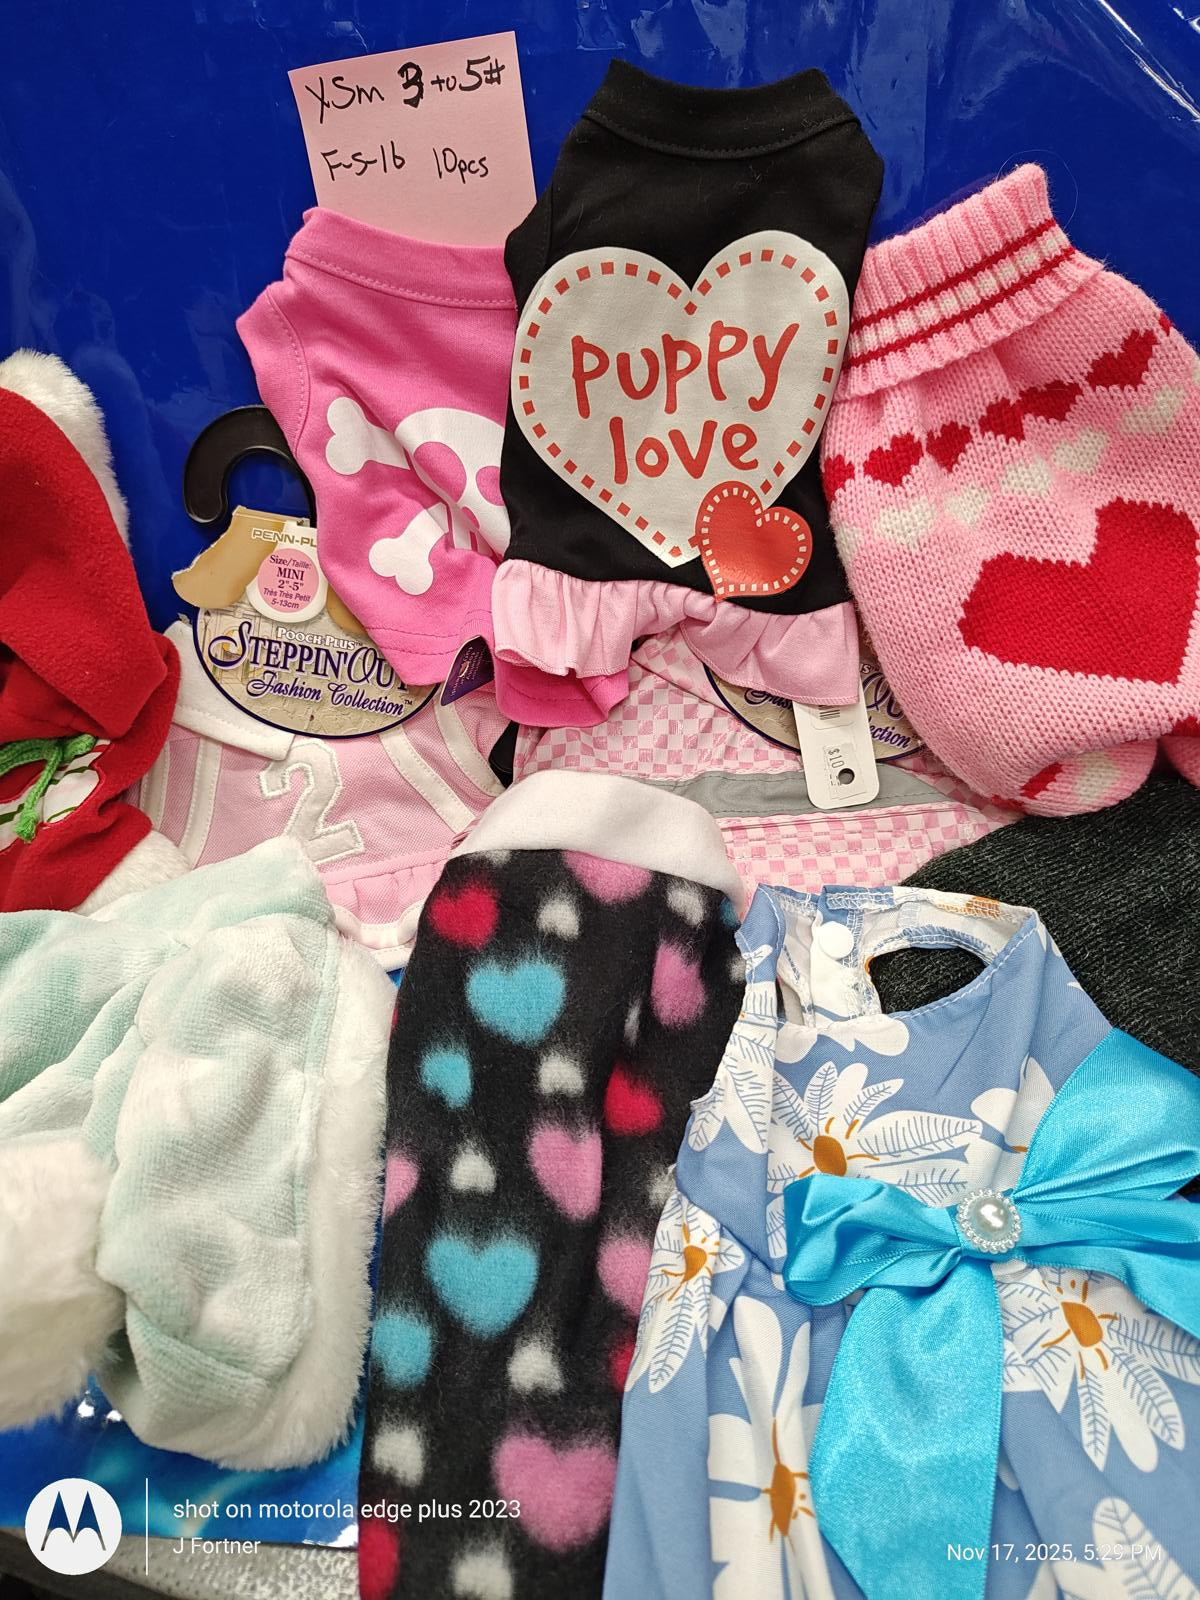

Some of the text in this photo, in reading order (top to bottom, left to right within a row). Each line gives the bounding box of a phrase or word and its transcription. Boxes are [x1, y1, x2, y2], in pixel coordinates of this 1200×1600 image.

[609, 416, 759, 485] love
[252, 528, 317, 548] PENN-PL
[276, 566, 305, 581] MINI
[271, 598, 300, 609] 5-13cm
[294, 593, 311, 602] Petit
[246, 670, 321, 701] Fashion
[327, 682, 404, 716] Collection
